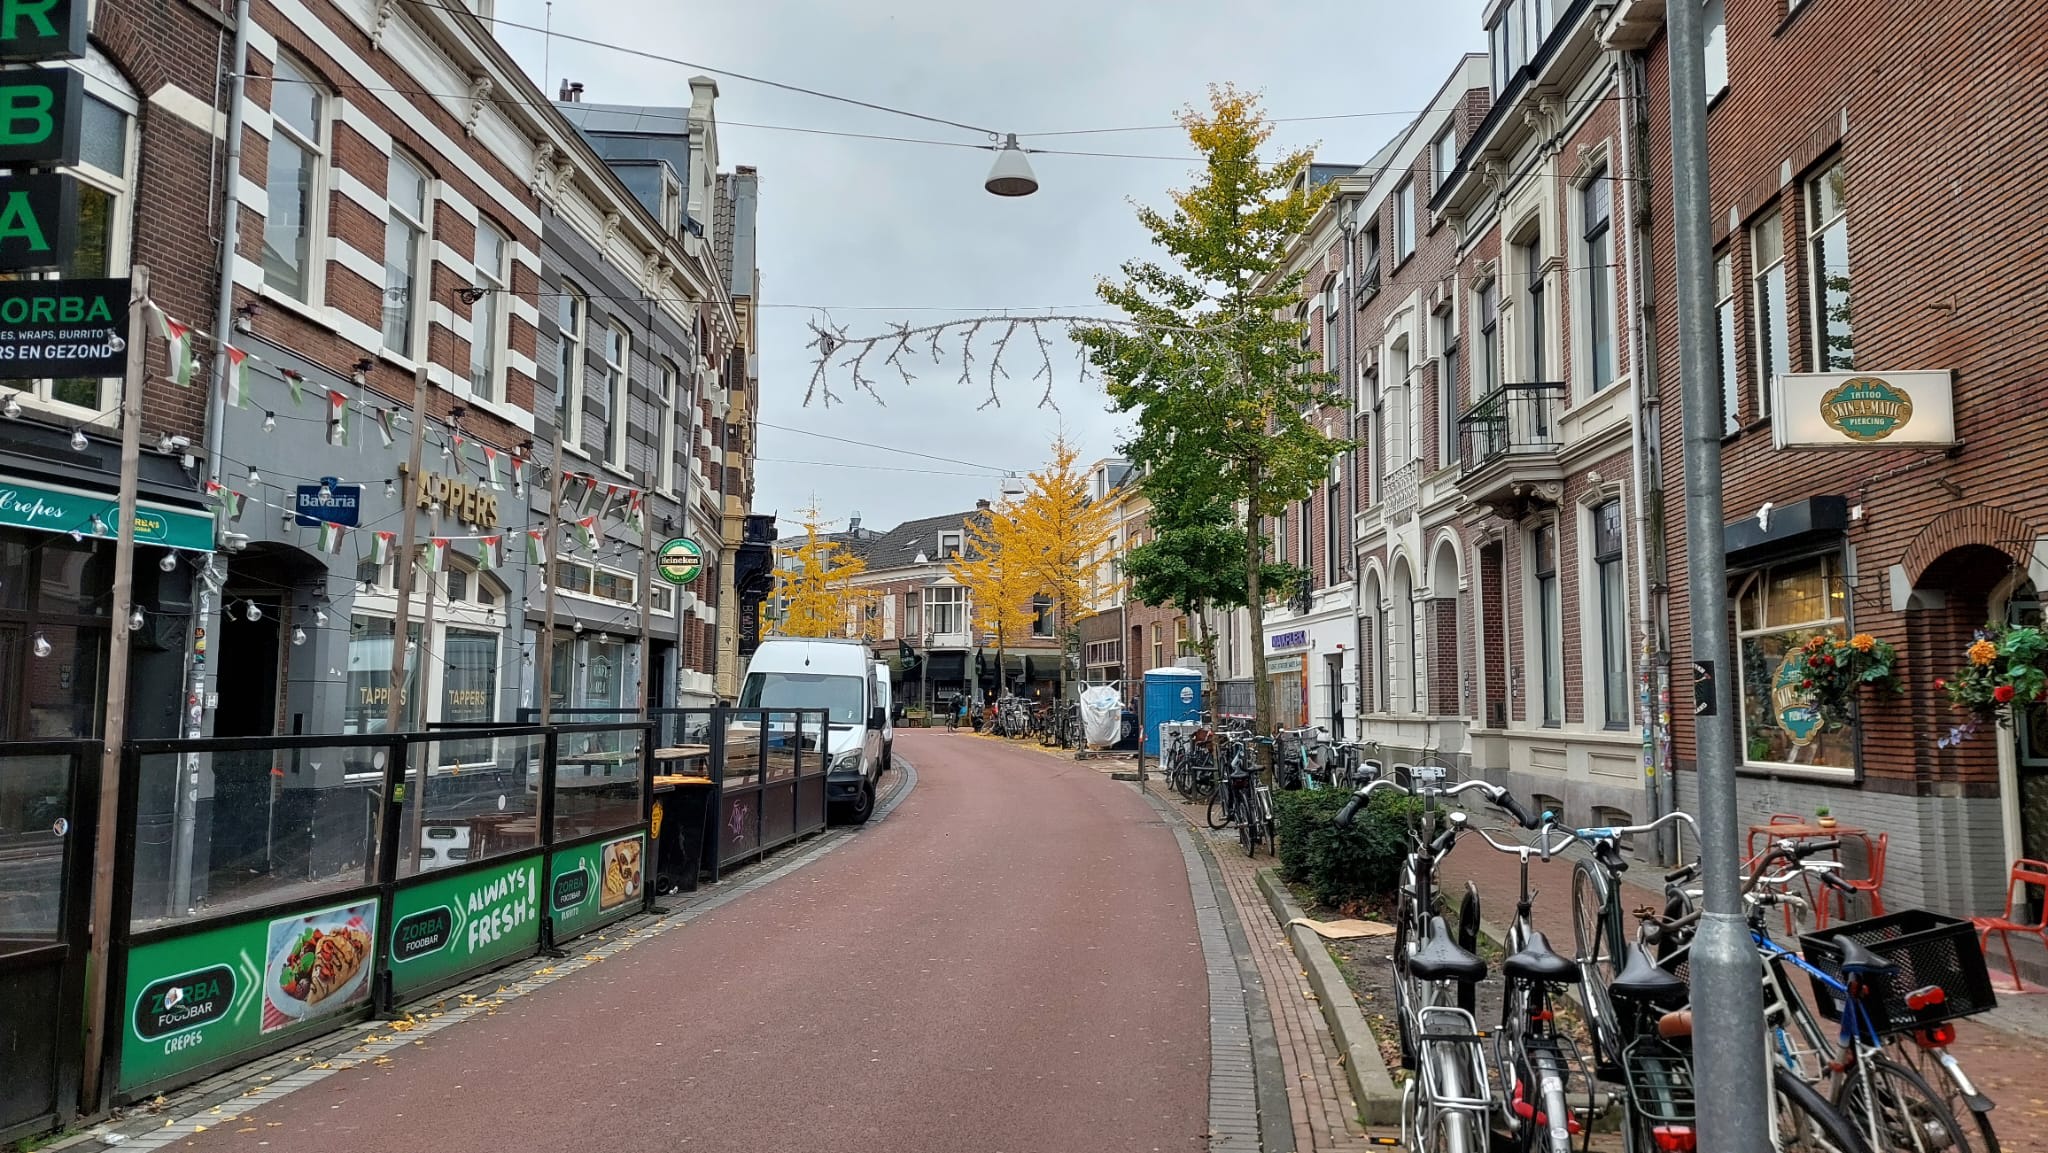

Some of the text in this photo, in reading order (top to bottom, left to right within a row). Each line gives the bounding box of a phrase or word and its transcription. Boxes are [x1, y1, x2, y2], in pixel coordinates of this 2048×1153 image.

[19, 330, 57, 340] WRAPS,
[59, 329, 110, 339] BURRITO
[19, 345, 41, 359] EN
[44, 344, 112, 359] GEZOND
[1850, 391, 1882, 399] TATTOO
[1831, 400, 1901, 418] SKIN-A-MATIC
[1849, 418, 1885, 426] PIERCING
[299, 494, 356, 508] Bavaria
[661, 556, 699, 564] Heineken
[360, 687, 407, 706] TAPPS
[449, 690, 485, 705] TAPPERS
[467, 866, 526, 916] ALWAYS
[402, 917, 444, 942] ZORBA
[405, 933, 439, 953] FOODBAR
[151, 978, 221, 1015] ZRBA
[157, 1001, 213, 1027] FOODBAR
[164, 1030, 203, 1055] CREPES
